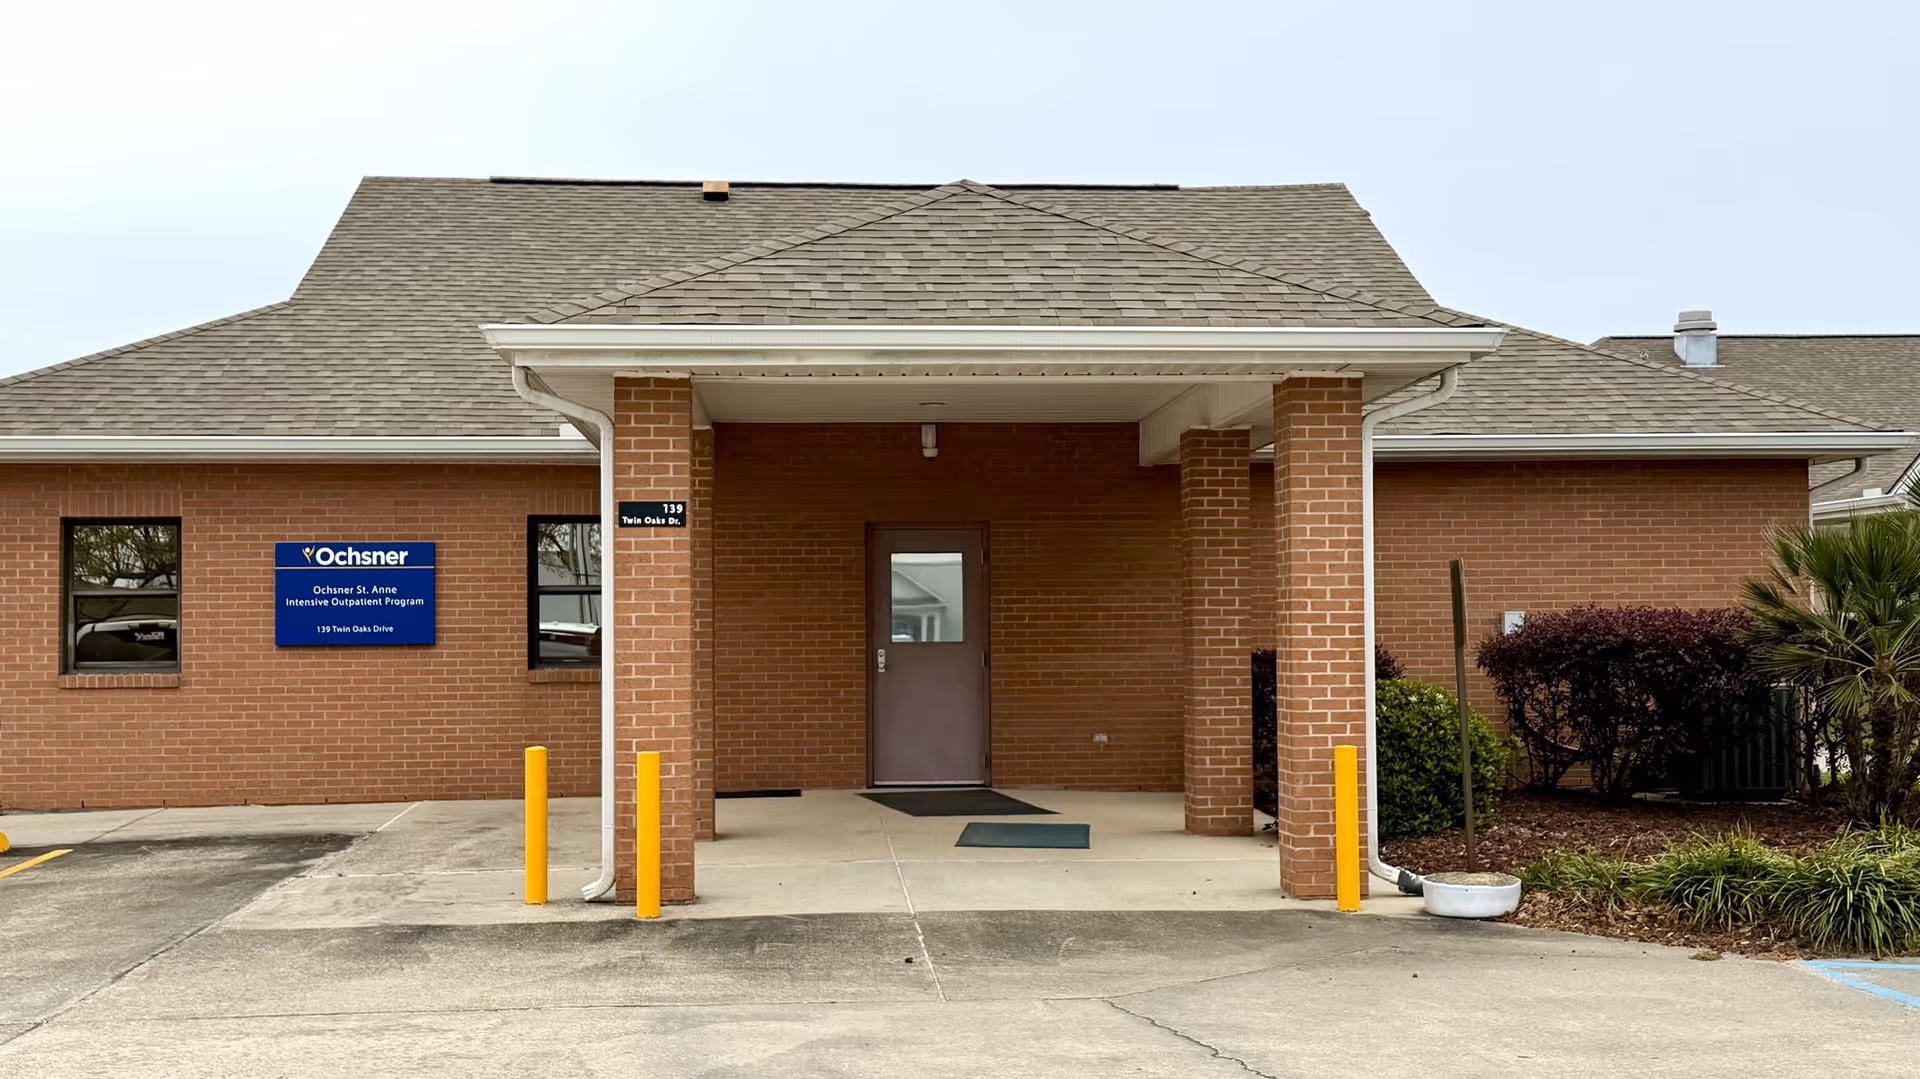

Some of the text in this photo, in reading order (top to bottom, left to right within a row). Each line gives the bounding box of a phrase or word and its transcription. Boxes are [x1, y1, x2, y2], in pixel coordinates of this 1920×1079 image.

[662, 503, 683, 513] 139
[622, 516, 642, 525] Twin
[644, 516, 666, 525] Oaks
[315, 547, 409, 566] Ochsner
[313, 585, 398, 595] Ochsner St. Anne
[285, 597, 424, 608] Intensive Outpatient Program
[316, 625, 394, 633] 139 Twin Oaks Drive
